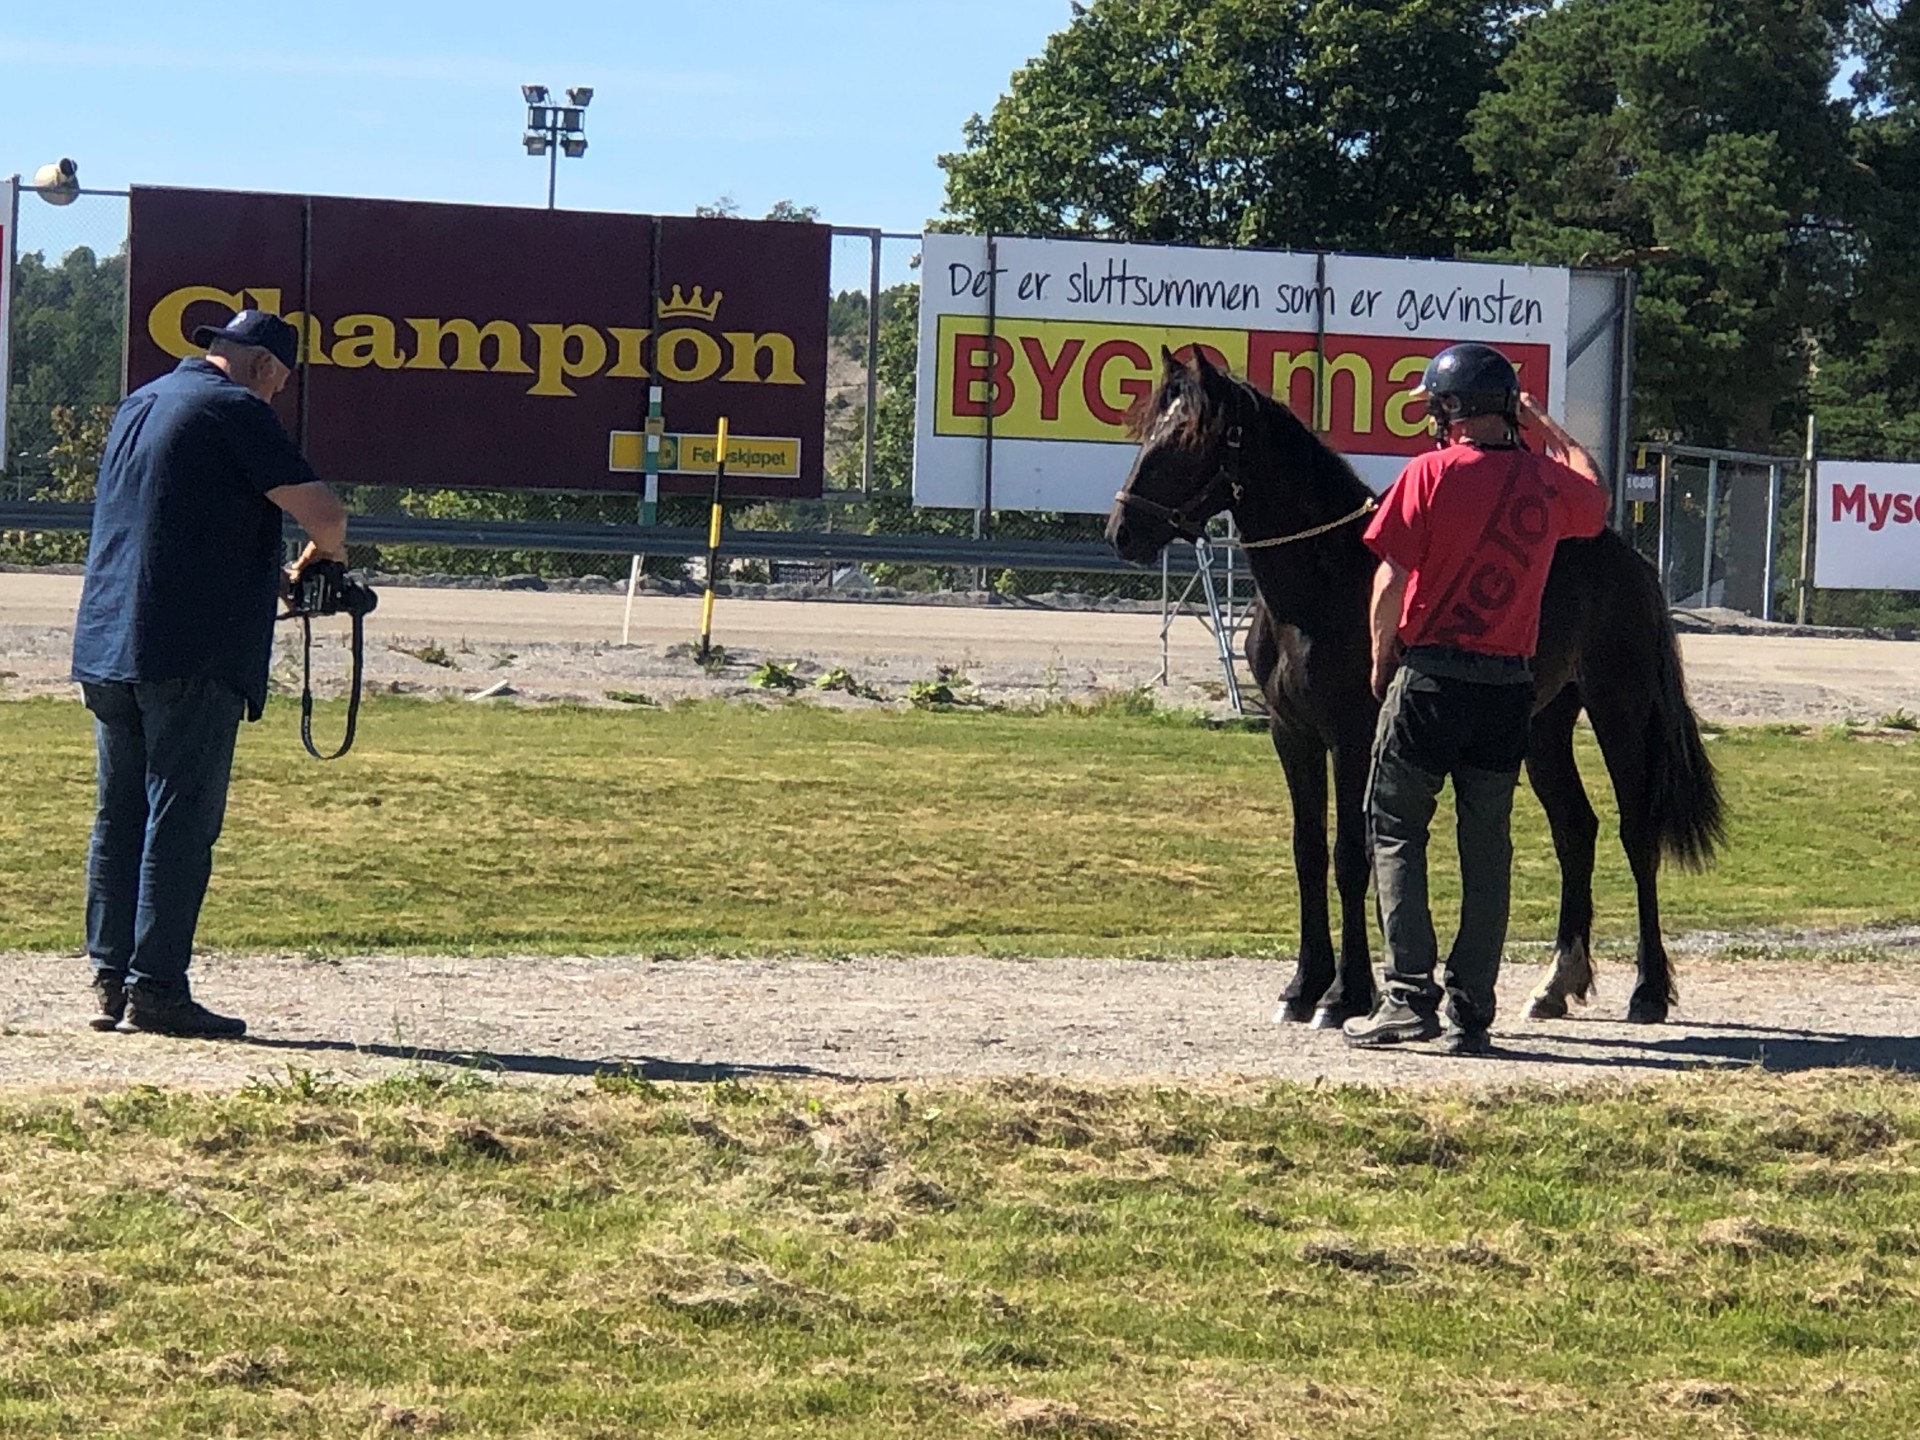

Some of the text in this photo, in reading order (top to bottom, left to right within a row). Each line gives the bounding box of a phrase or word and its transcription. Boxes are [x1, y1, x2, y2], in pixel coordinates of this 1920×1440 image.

[1017, 270, 1051, 300] er
[1066, 257, 1261, 312] sluttsummen
[1275, 282, 1336, 316] som
[1350, 288, 1383, 319] er
[1396, 277, 1543, 332] gevinsten
[148, 284, 806, 397] Champion
[692, 445, 788, 469] Felskjøpet
[1831, 483, 1920, 532] Mys
